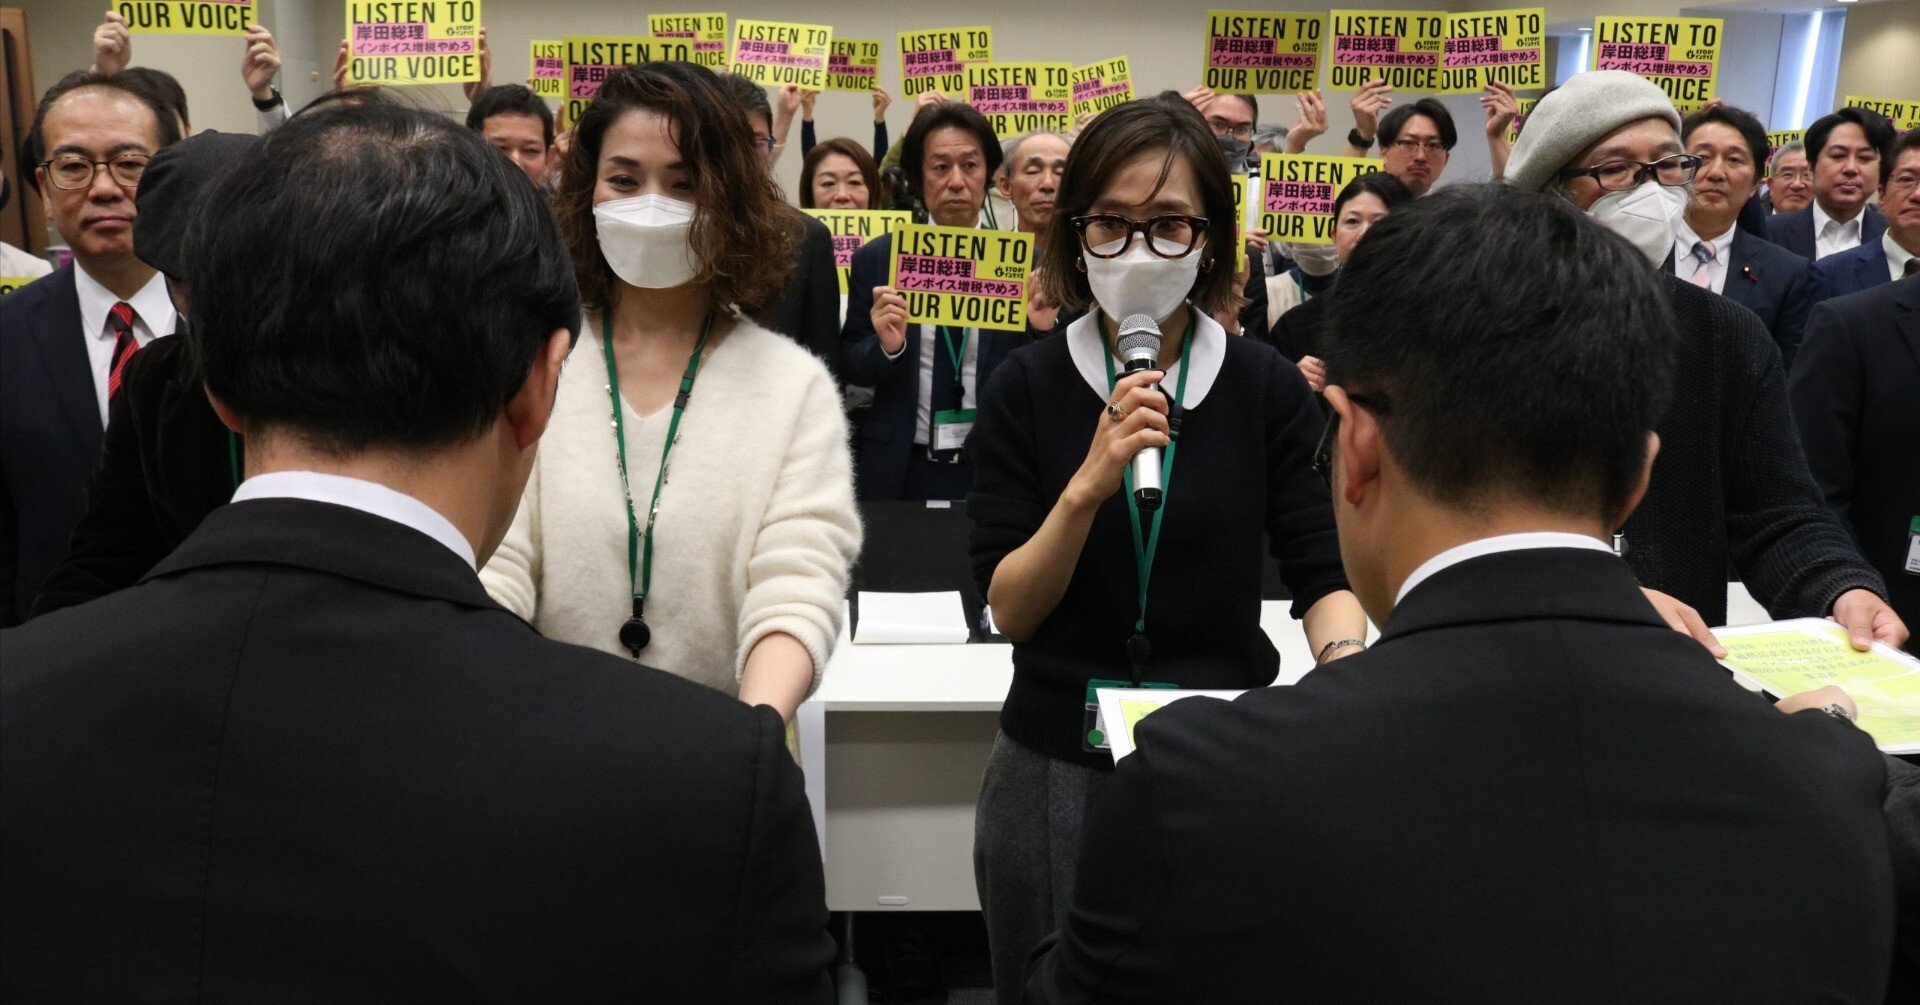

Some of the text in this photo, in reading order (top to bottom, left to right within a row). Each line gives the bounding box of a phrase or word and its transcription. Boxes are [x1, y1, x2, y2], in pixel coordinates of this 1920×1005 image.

[119, 2, 252, 31] OUR VOICE
[352, 1, 474, 24] LISTEN TO
[356, 25, 424, 40] 岸田総理
[651, 16, 724, 32] LISTEN TO
[1211, 16, 1320, 40] LISTEN TO
[1335, 16, 1442, 38] LISTEN TO
[1445, 14, 1540, 39] ISTEN TO
[738, 25, 828, 46] LISTEN TO
[901, 31, 988, 53] LISTEN TO
[1599, 22, 1717, 47] LISTEN TO
[357, 41, 471, 53] インボイス増税やめろ
[533, 44, 562, 58] LIST
[568, 42, 688, 65] LISTEN TO
[739, 41, 789, 54] 岸田総理
[831, 42, 856, 56] TEN
[862, 43, 878, 57] TO
[1213, 38, 1274, 54] 岸田総理
[1337, 37, 1396, 52] 岸田総理
[1444, 38, 1499, 54] 岸田総理
[1601, 44, 1666, 61] 岸田総理
[352, 55, 474, 80] OUR VOICE
[695, 51, 725, 66] OICE
[738, 53, 822, 67] インボイス増税やめろ
[905, 51, 953, 65] 岸田総理
[1213, 54, 1313, 67] インボイス増税やめろ
[1337, 53, 1436, 65] インボイス増税やめろ
[1444, 51, 1537, 66] インボイス増税やめろ
[733, 63, 766, 81] OUR
[773, 66, 822, 86] VOICE
[906, 63, 964, 75] インボイス増税
[969, 67, 1037, 87] LISTEN
[1045, 67, 1068, 87] TO
[1071, 59, 1126, 85] STEN TO
[1332, 66, 1438, 89] OUR VOICE
[1442, 64, 1540, 90] OUR VOICE
[1600, 61, 1709, 75] インボイス増税やめろ
[532, 78, 560, 93] OUR
[836, 75, 876, 90] VOICE
[904, 76, 936, 96] OUR
[1207, 67, 1315, 90] OUR VOICE
[973, 87, 1028, 100] 岸田総理
[1094, 91, 1131, 111] VOICE
[974, 101, 1066, 112] インボイス増税やめろ
[1910, 105, 1920, 120] T
[1014, 114, 1068, 134] VOICE
[1766, 133, 1799, 147] STEN
[1266, 160, 1343, 185] LISTEN
[1268, 182, 1331, 200] 岸田総理
[1262, 214, 1304, 238] OUR
[897, 230, 1028, 264] LISTEN TO
[900, 257, 973, 278] 岸田総理
[899, 275, 1020, 296] インボイス増税やめろ
[951, 294, 1021, 325] VOICE
